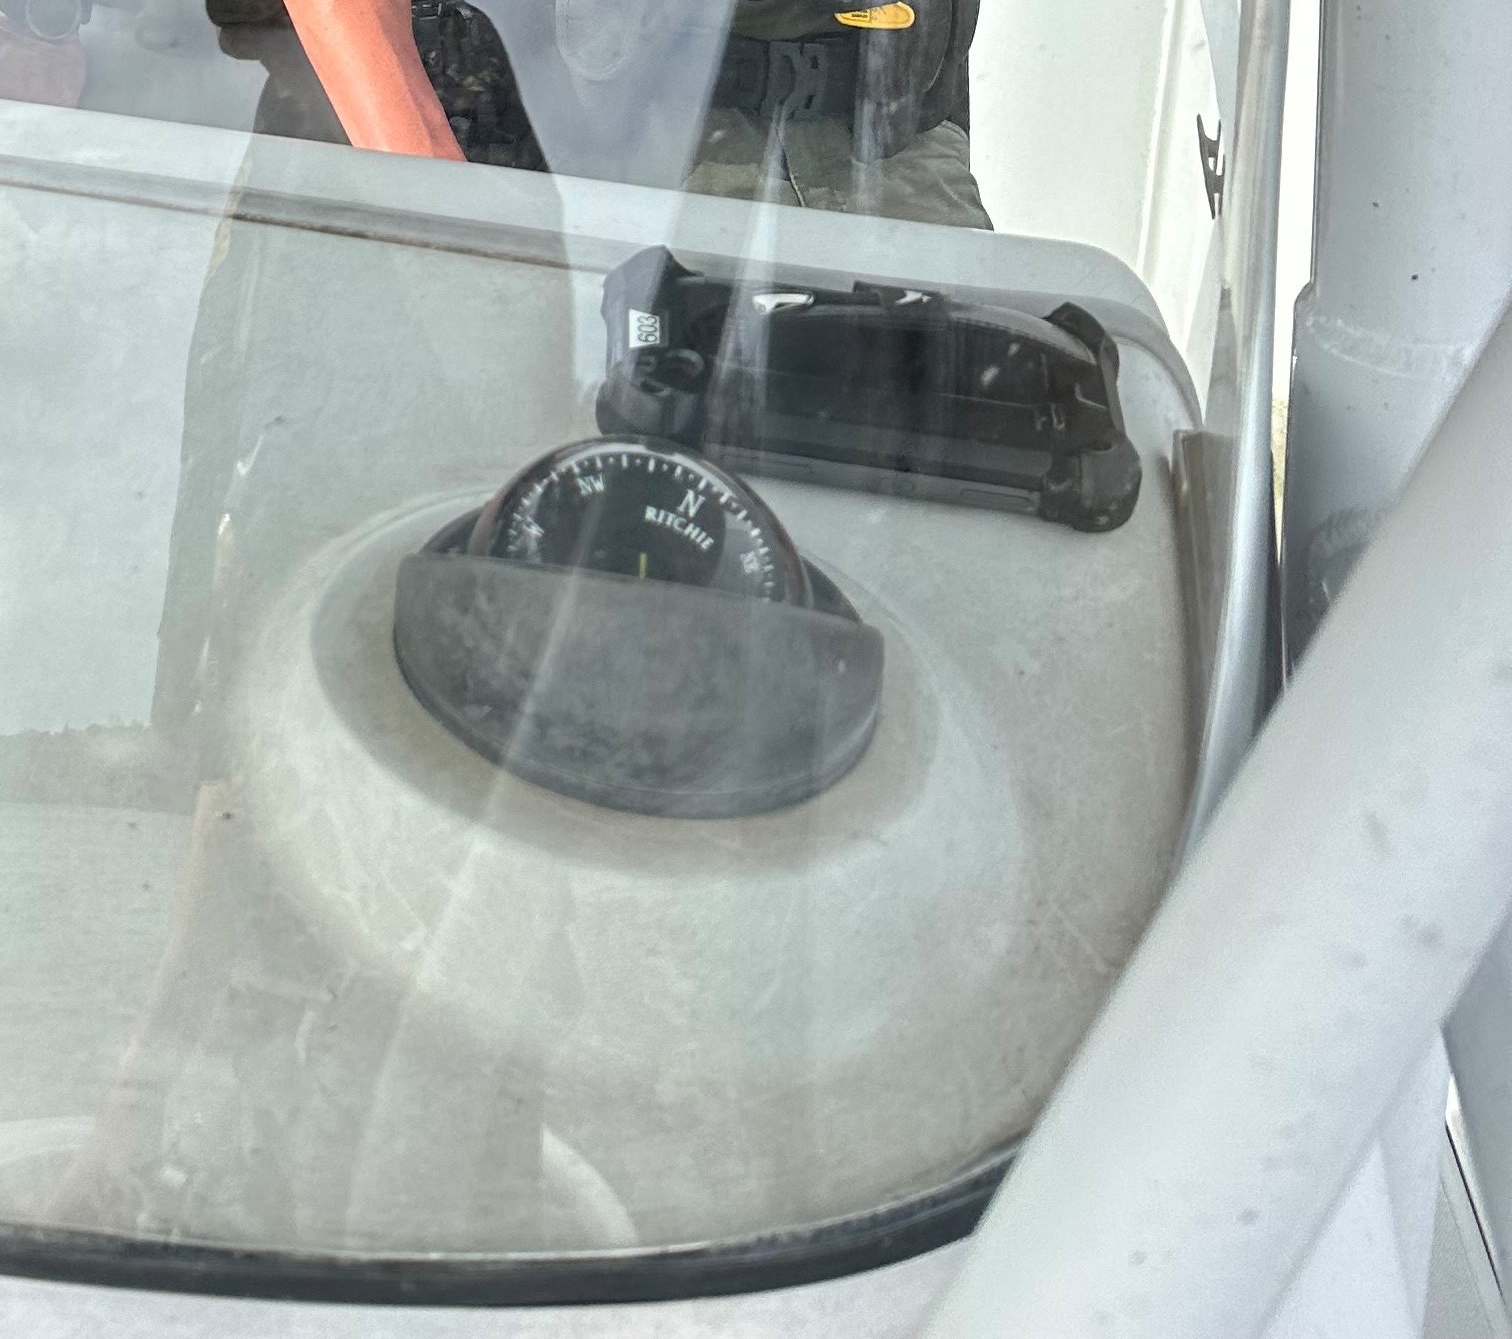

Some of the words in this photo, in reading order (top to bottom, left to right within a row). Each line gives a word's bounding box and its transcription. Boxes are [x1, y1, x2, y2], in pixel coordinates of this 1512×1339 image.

[637, 315, 658, 343] 603
[576, 472, 606, 497] NW
[679, 489, 706, 518] N
[644, 505, 715, 552] RITCHIE
